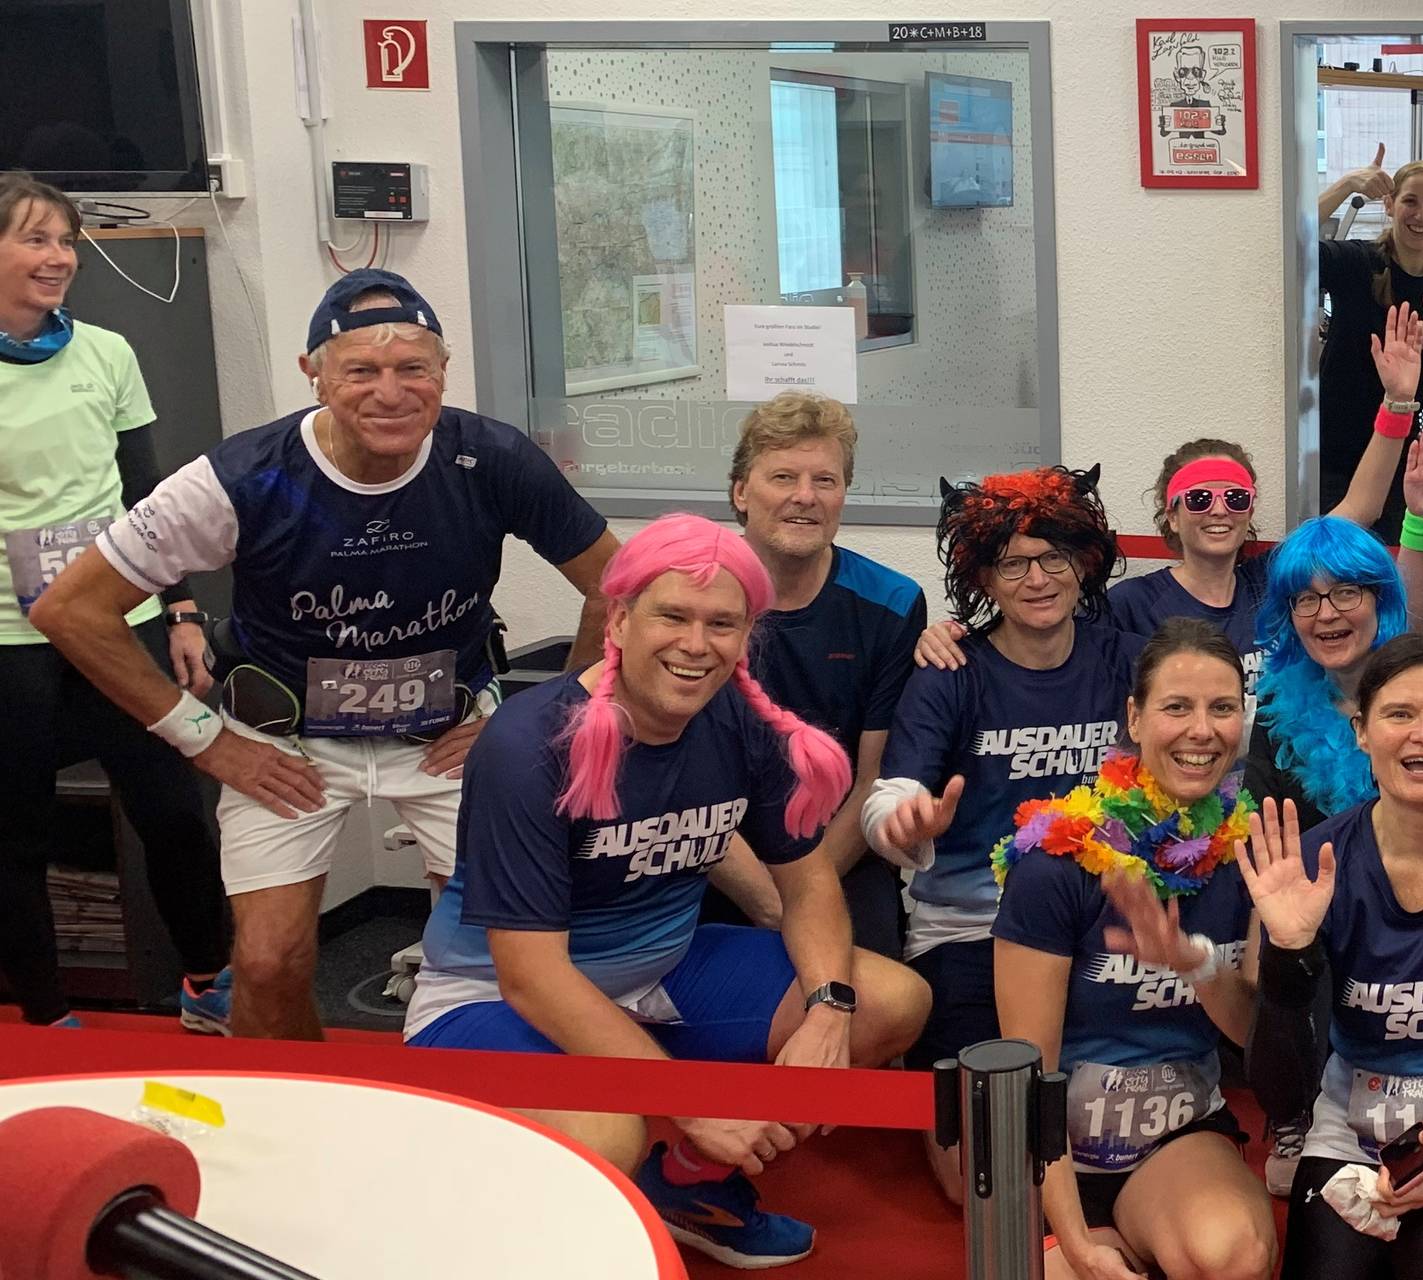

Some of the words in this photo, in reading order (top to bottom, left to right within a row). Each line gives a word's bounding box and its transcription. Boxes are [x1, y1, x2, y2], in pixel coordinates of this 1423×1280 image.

[331, 549, 368, 558] PALMA
[371, 541, 429, 555] MARATHON
[289, 584, 395, 621] Palma
[326, 589, 479, 652] Marathon
[339, 680, 426, 713] 249
[971, 720, 1118, 756] AUSDAUER
[575, 798, 748, 859] AUSDAUER
[1132, 978, 1200, 1011] SCH
[1085, 1091, 1196, 1137] 1136
